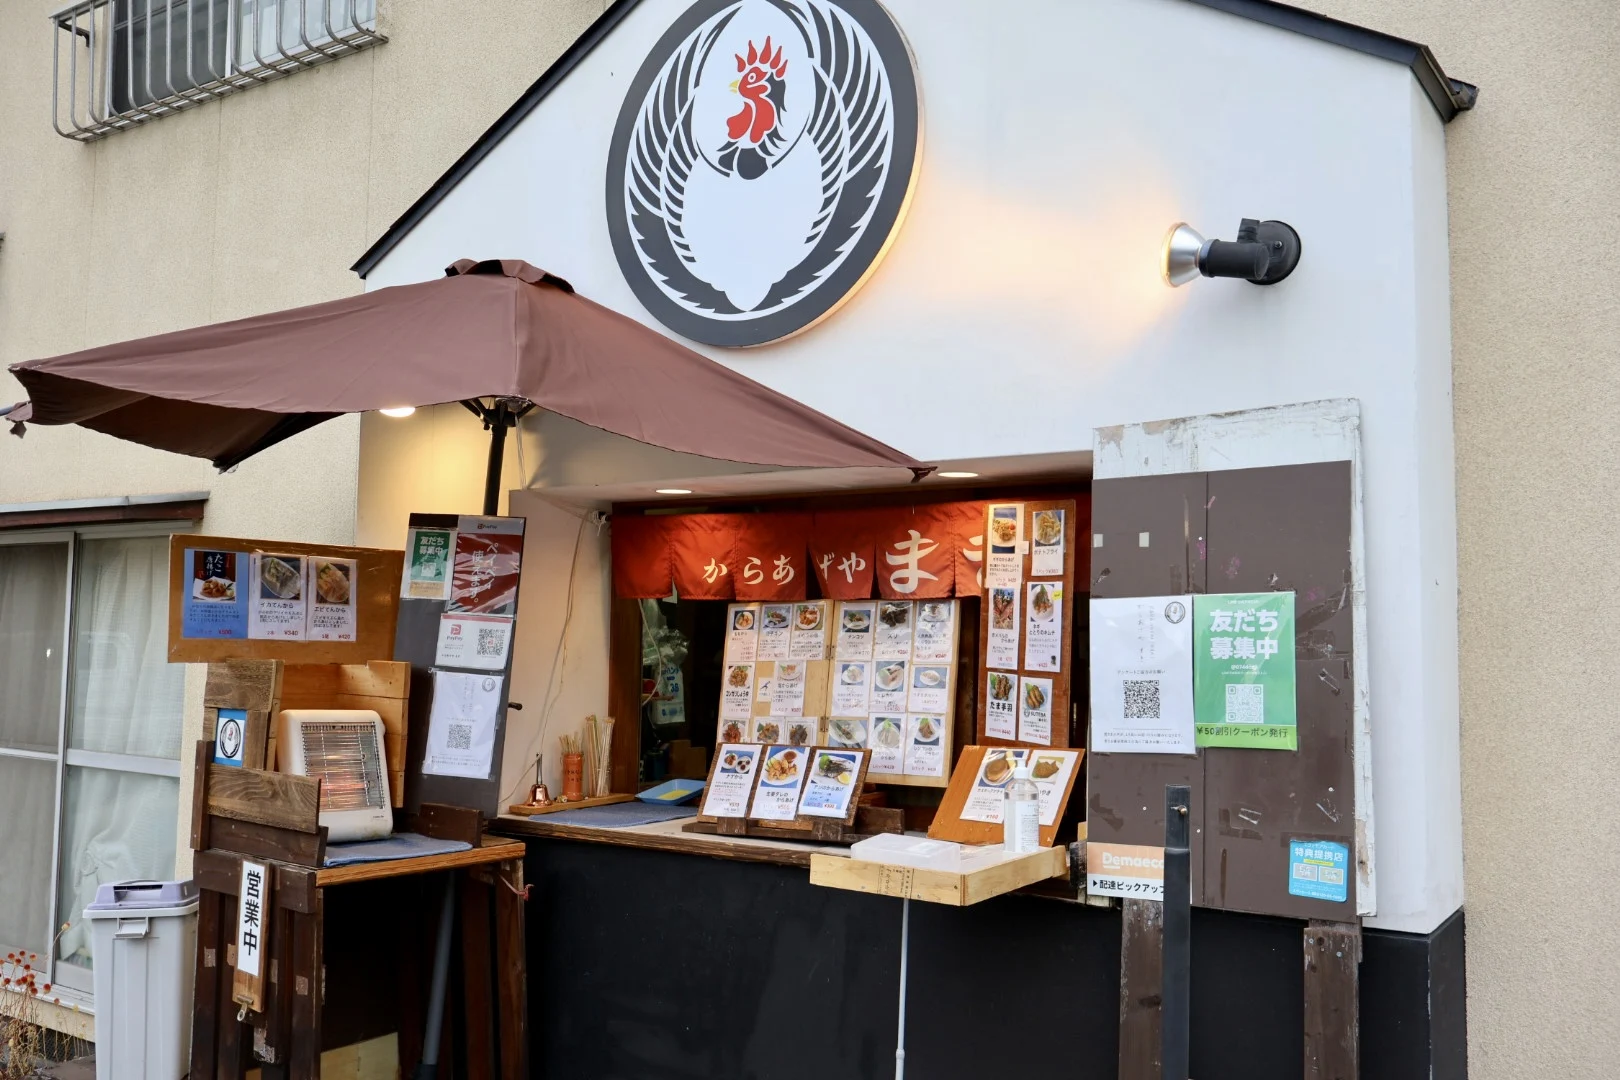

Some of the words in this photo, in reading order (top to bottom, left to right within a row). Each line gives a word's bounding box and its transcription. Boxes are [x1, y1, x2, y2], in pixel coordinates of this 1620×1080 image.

[701, 551, 867, 586] からあげや
[1209, 608, 1279, 633] 友だち
[1209, 636, 1279, 660] 募集中
[990, 701, 1013, 712] たま手羽
[244, 869, 262, 956] 営業中
